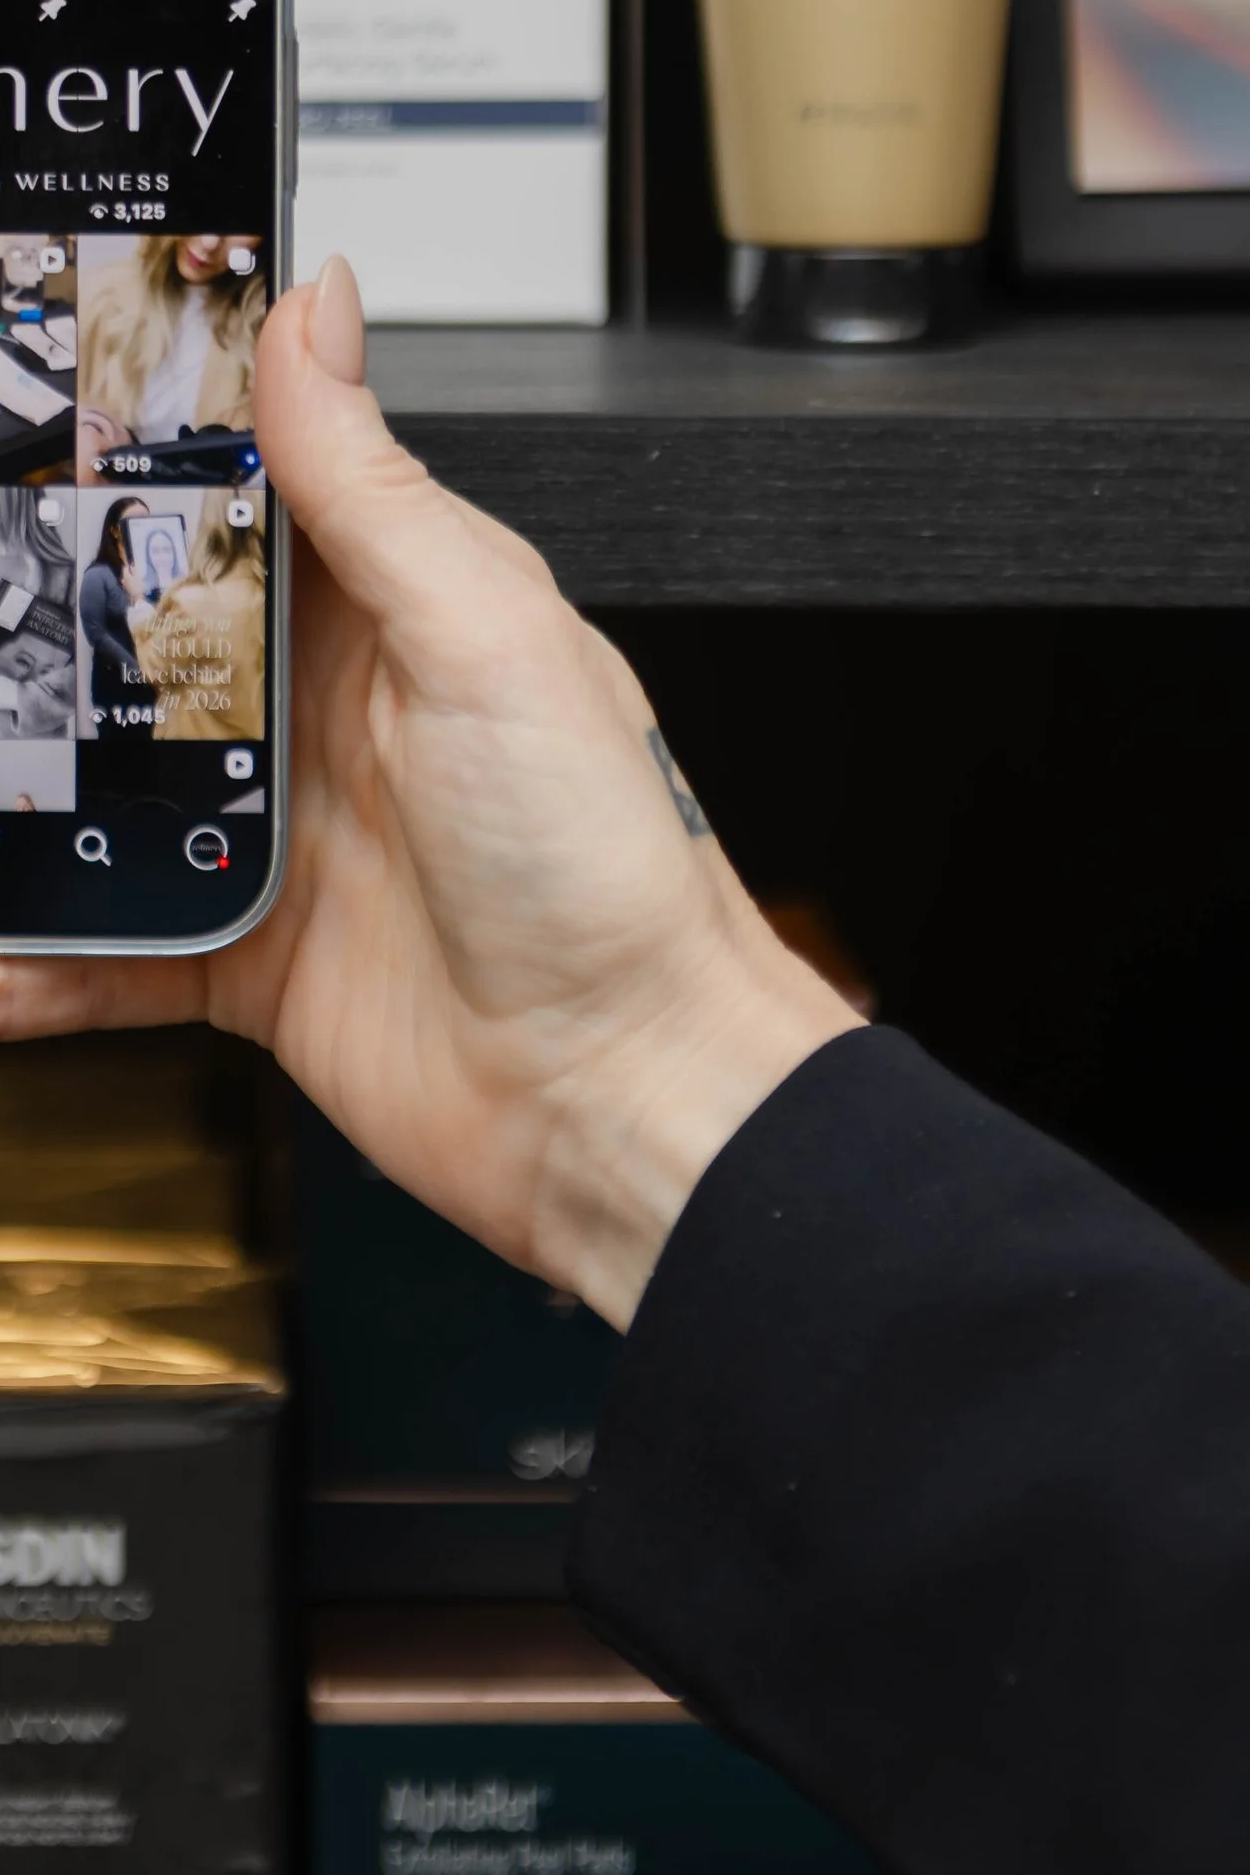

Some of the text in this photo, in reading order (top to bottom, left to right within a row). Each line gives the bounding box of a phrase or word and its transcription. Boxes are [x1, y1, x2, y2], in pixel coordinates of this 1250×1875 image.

[14, 172, 170, 191] WELLNESS
[113, 202, 166, 224] 3,125
[113, 457, 152, 473] 509
[172, 663, 232, 685] behind
[184, 690, 232, 711] 2026
[112, 708, 166, 728] 1,045
